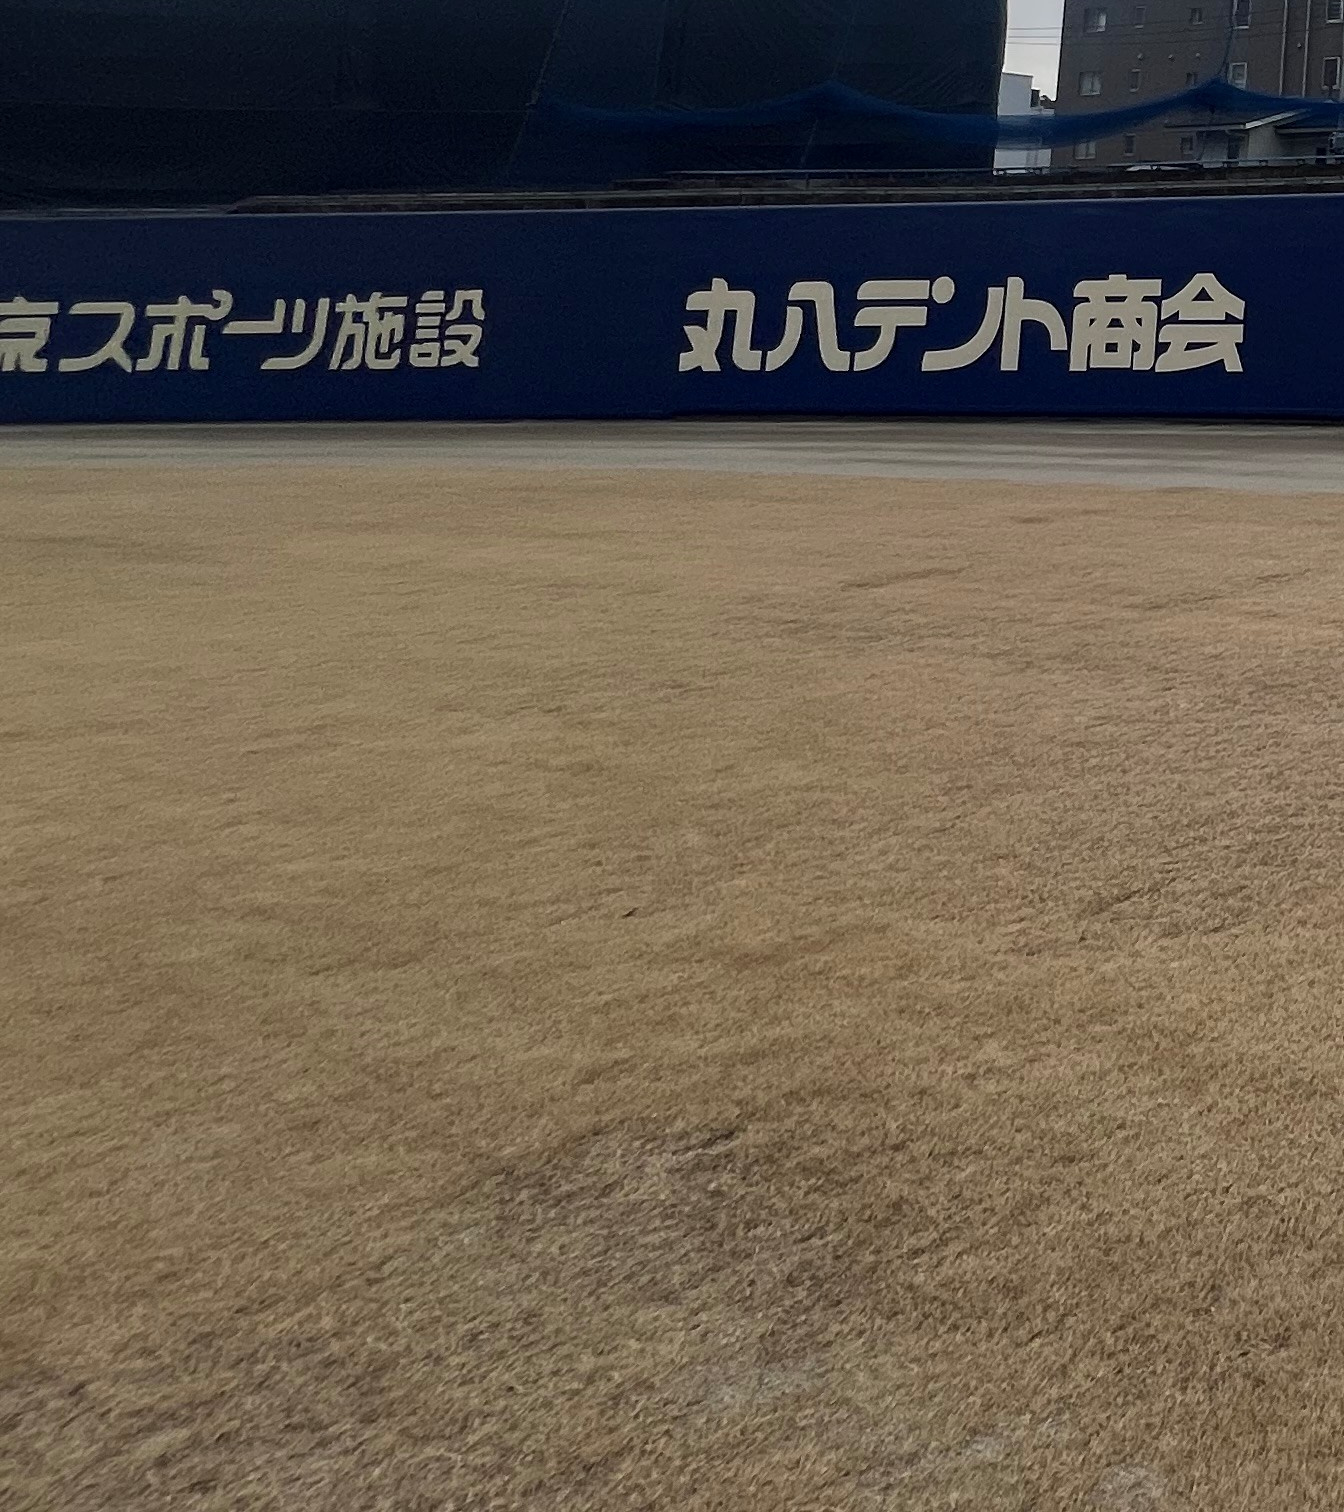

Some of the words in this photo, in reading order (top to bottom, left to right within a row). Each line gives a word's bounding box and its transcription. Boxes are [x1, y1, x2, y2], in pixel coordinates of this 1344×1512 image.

[678, 273, 1246, 372] 丸八テント商会
